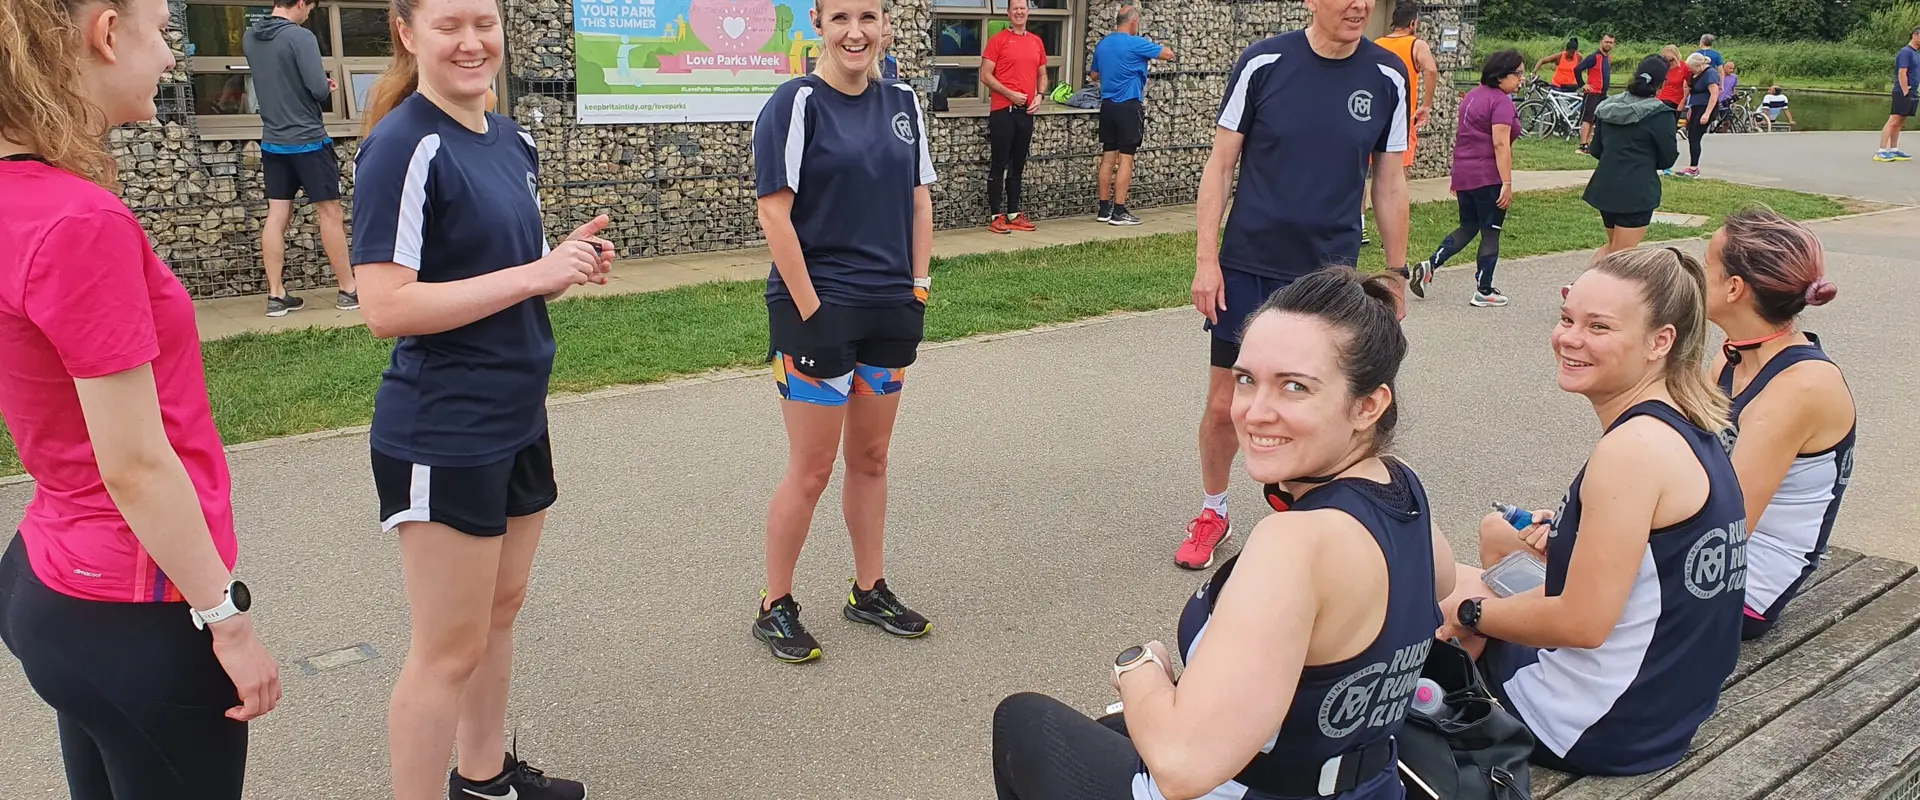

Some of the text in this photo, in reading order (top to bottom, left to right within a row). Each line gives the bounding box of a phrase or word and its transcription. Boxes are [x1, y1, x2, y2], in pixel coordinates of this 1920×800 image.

[581, 4, 656, 18] YOUR PARK
[581, 17, 656, 29] THIS SUMMER
[686, 54, 780, 66] Love Parks Week
[584, 103, 686, 111] keepbritaintidy.org/loveparks
